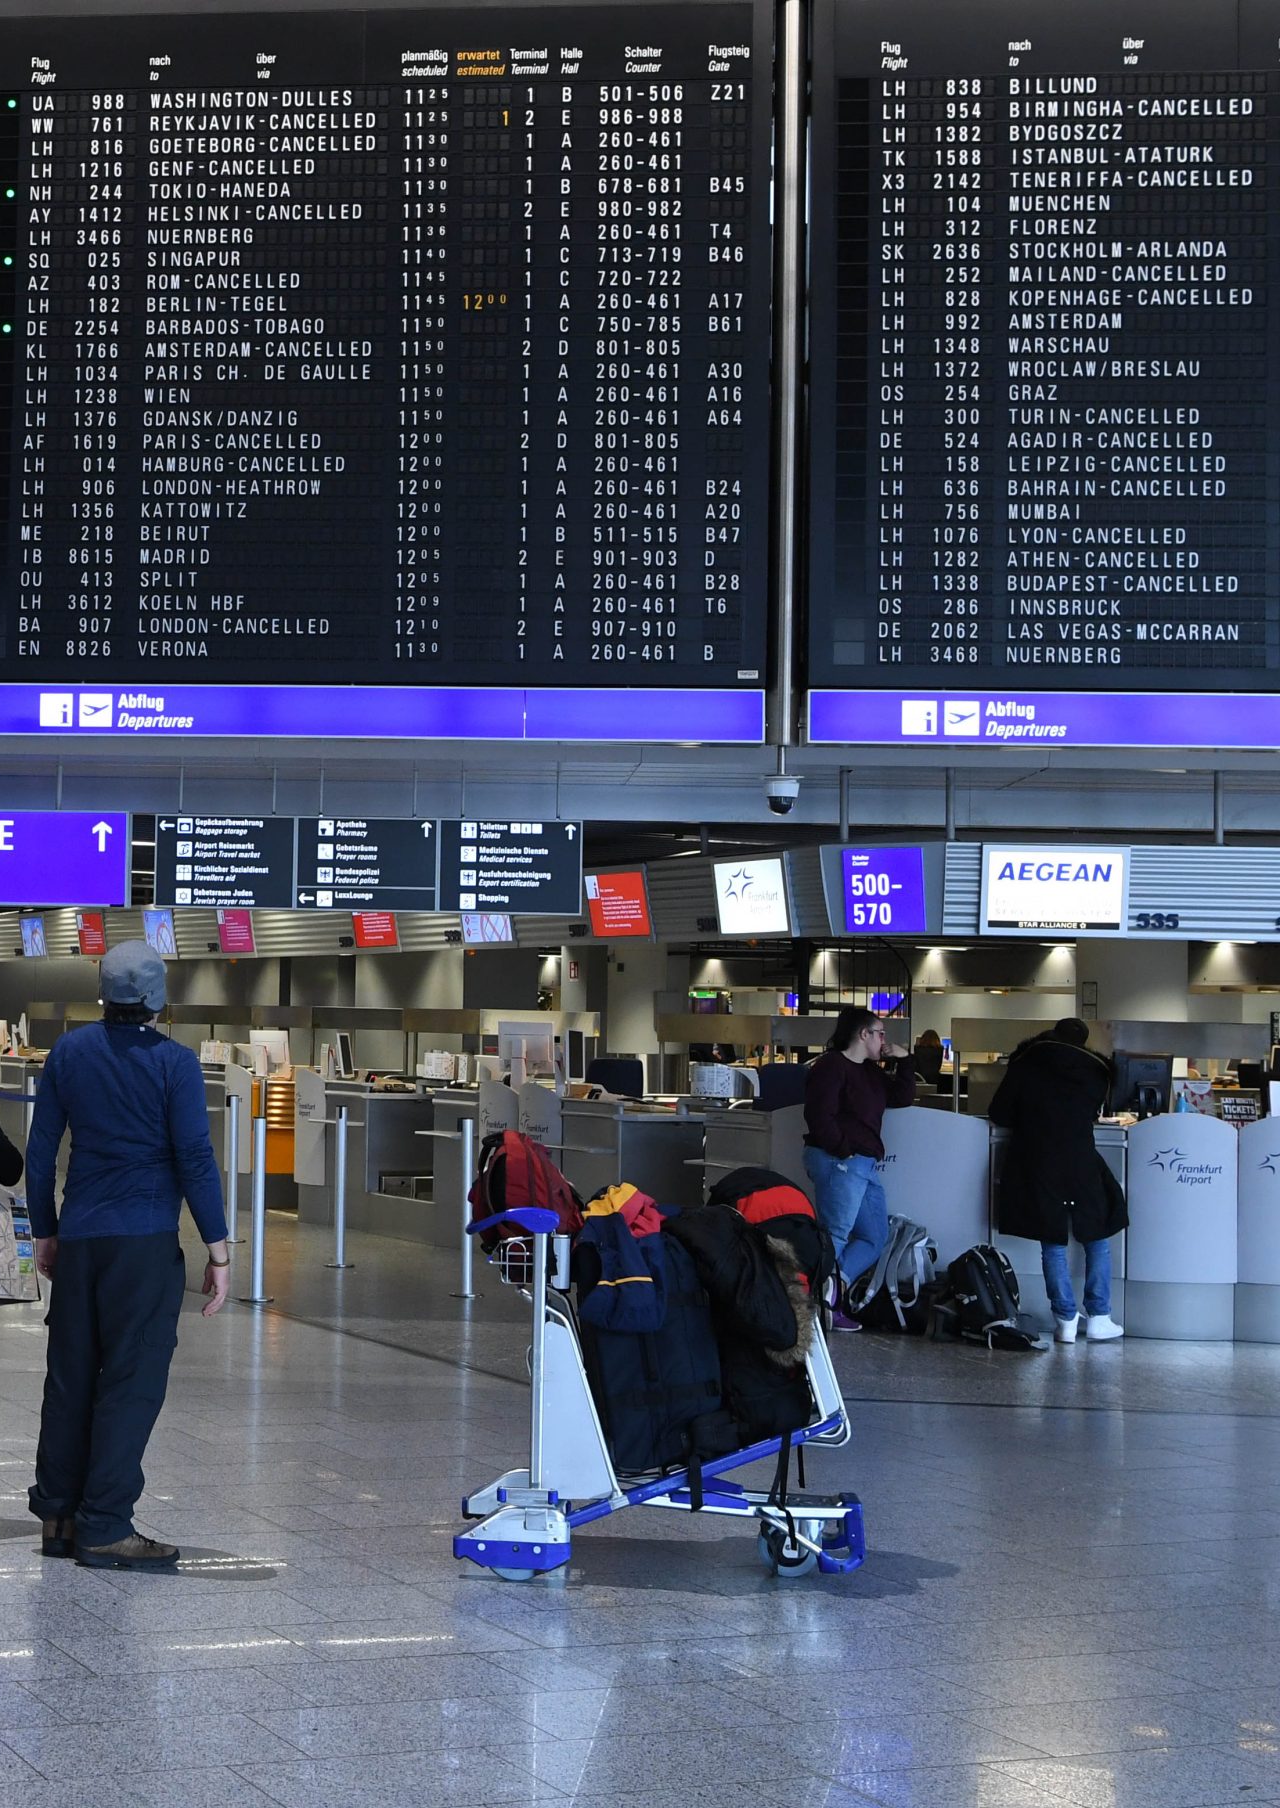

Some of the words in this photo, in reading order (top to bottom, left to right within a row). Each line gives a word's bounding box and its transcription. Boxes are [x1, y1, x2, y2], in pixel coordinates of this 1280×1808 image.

[561, 48, 583, 58] Halle
[561, 63, 579, 74] Hall
[600, 85, 683, 102] 501-506
[711, 84, 743, 100] Z21
[1010, 77, 1096, 94] BILLUND
[33, 96, 54, 111] UA
[92, 94, 124, 110] 988
[151, 90, 352, 108] WASHINGTON-DULLES
[1010, 98, 1252, 118] BIRMINGHA-CANCELLED
[1010, 124, 1122, 141] BYDGOSZCZ
[1013, 146, 1213, 165] ISTANBUL-ATATURK
[149, 182, 290, 199] TOKIO-HANEDA
[710, 177, 744, 193] B45
[1009, 195, 1110, 211] MUENCHEN
[1010, 219, 1096, 235] FLORENZ
[148, 228, 253, 244] NUERNBERG
[148, 251, 240, 267] SINGAPUR
[147, 296, 286, 312] BERLIN-TEGEL
[146, 318, 324, 335] BARBADOS-TOBAGO
[1009, 313, 1121, 329] AMSTERDAM
[1009, 337, 1109, 353] WARSCHAU
[145, 365, 202, 380] PARIS
[217, 365, 247, 380] CH.
[265, 365, 285, 380] DE
[301, 364, 370, 380] GAULLE
[1009, 361, 1199, 377] WROCLAW/BRESLAU
[145, 388, 189, 403] WIEN
[1009, 385, 1057, 400] GRAZ
[144, 411, 297, 426] GDANSK/DANZIG
[143, 480, 320, 495] LONDON-HEATHROW
[141, 503, 246, 518] KATTOWITZ
[1009, 504, 1079, 519] MUMBAI
[141, 526, 209, 541] BEIRUT
[140, 549, 209, 564] MADRID
[140, 572, 197, 587] SPLIT
[140, 595, 196, 610] KOELN
[212, 595, 244, 610] HBF
[1011, 599, 1120, 616] INNSBRUCK
[1008, 623, 1043, 639] LAS
[1059, 623, 1238, 640] VEGAS-MCCARRAN
[138, 641, 207, 656] VERONA
[1007, 647, 1120, 664] NUERNBERG
[118, 693, 164, 712] Abflug
[985, 701, 1035, 720] Abflug
[117, 712, 194, 730] Departures
[985, 721, 1067, 740] Departures
[195, 818, 264, 828] Gepäckaufbewahrung
[336, 821, 367, 829] Apotheke
[479, 823, 508, 831] Toiletten
[195, 827, 222, 836] Baggage
[224, 828, 248, 836] storage
[336, 829, 368, 838] Pharmacy
[479, 831, 500, 839] Toilets
[194, 841, 218, 851] Airport
[219, 842, 255, 850] Reisemarkt
[479, 847, 522, 855] Medizinische
[523, 847, 548, 855] Dienste
[194, 850, 217, 859] Airport
[238, 851, 261, 859] market
[335, 853, 356, 862] Prayer
[194, 865, 228, 873] Kirchlicher
[230, 866, 269, 874] Sozialdienst
[335, 868, 380, 876] Bundespolizei
[478, 871, 551, 880] Ausfuhrbescheinigung
[997, 862, 1112, 882] AEGEAN
[193, 874, 225, 882] Travellers
[225, 874, 236, 882] aid
[334, 876, 357, 884] Federal
[358, 877, 379, 885] police
[478, 879, 500, 888] Export
[193, 888, 231, 897] Gebetsraum
[233, 889, 253, 897] Juden
[335, 892, 373, 900] LuxxLounge
[478, 894, 509, 903] Shopping
[193, 897, 215, 905] Jewish
[217, 898, 237, 907] prayer
[854, 903, 892, 926] 570
[1136, 912, 1180, 930] 535
[1018, 921, 1038, 929] STAR
[1040, 921, 1077, 929] ALLIANCE
[1223, 1105, 1255, 1114] TICKETS
[1177, 1163, 1223, 1174] Frankfurt
[1176, 1174, 1212, 1186] Airport
